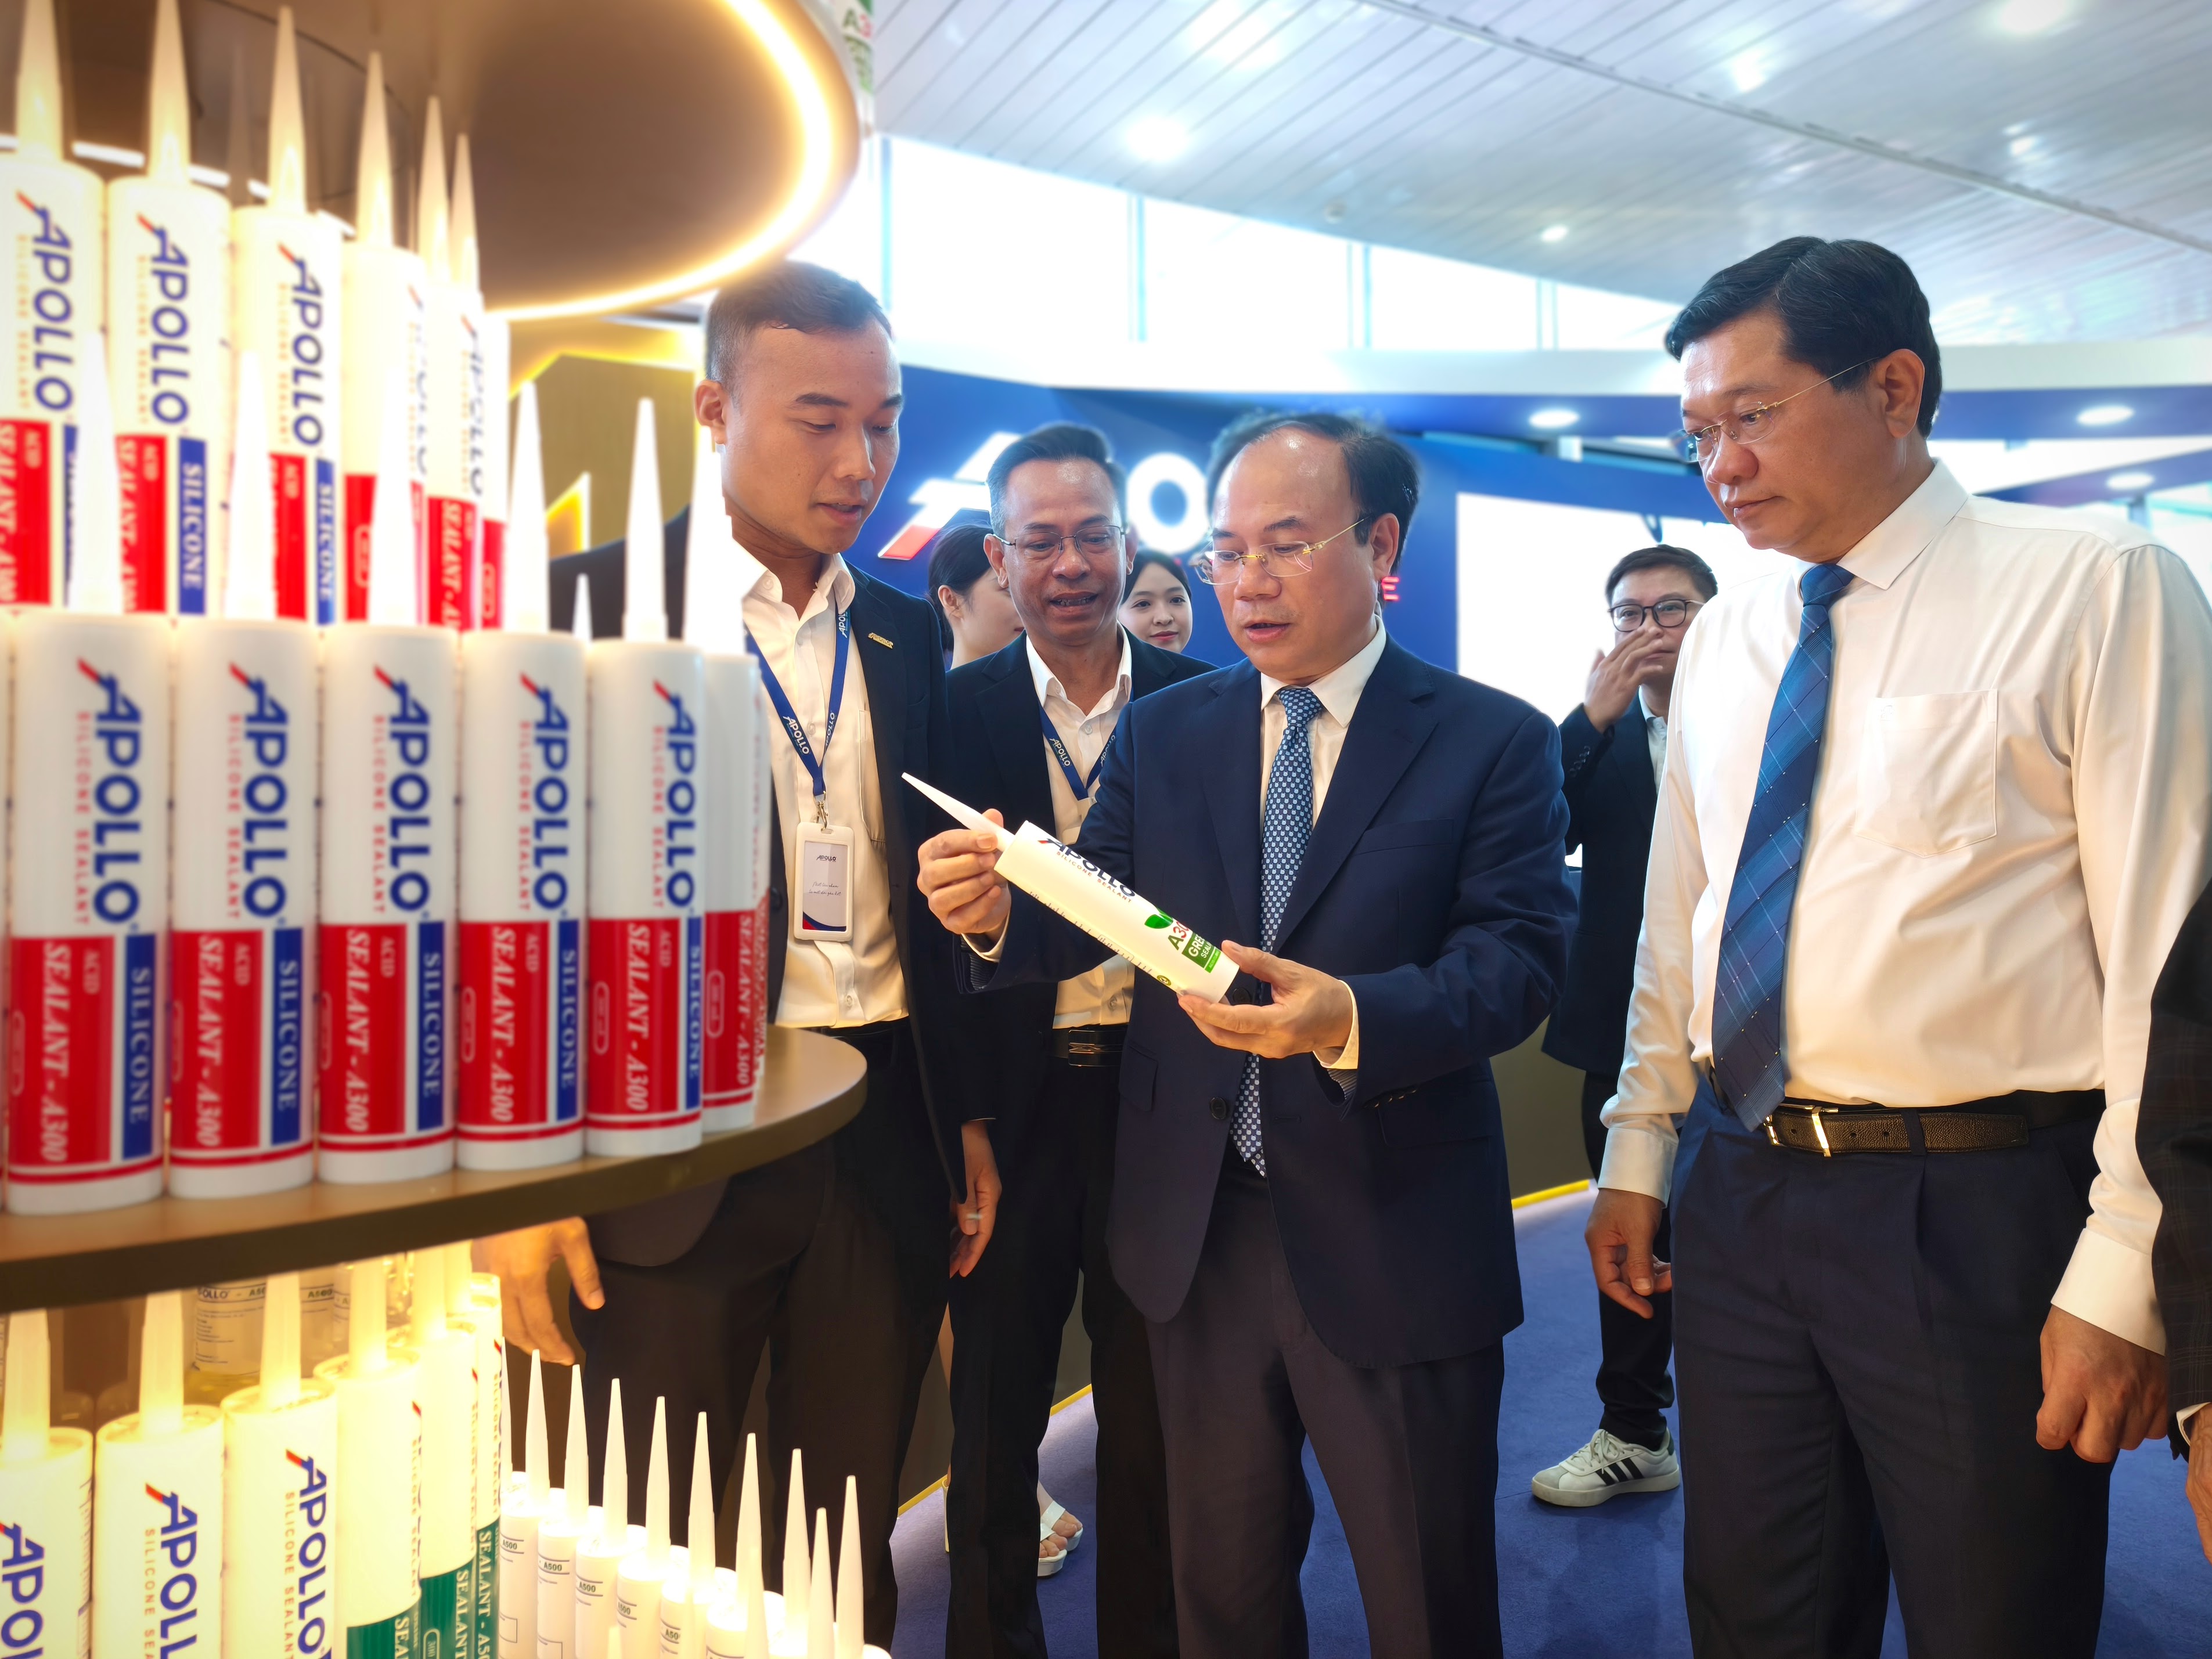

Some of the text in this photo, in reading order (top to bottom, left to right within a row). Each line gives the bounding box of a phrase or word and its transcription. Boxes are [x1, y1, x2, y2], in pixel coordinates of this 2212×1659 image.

[16, 191, 74, 411] APOLLO
[137, 212, 190, 425] APOLLO
[278, 243, 323, 447] APOLLO
[182, 463, 203, 589] SILICONE
[838, 613, 848, 638] APOL
[783, 716, 810, 754] APOLLO
[1049, 738, 1071, 766] APOLLO
[77, 657, 142, 924] APOLLO
[228, 662, 288, 918] APOLLO
[373, 663, 431, 913] APOLLO
[520, 672, 569, 911] APOLLO
[653, 679, 696, 908] APOLLO
[1037, 838, 1135, 897] APOLLO
[1056, 851, 1132, 903] SILICONE SEALANT
[346, 929, 370, 1055] SEALANT
[491, 926, 516, 1047] SEALANT
[627, 922, 651, 1040] SEALANT
[738, 914, 752, 1015] SEALANT
[1188, 933, 1205, 957] GRE
[1201, 942, 1212, 958] SEAL
[43, 940, 71, 1078] SEALANT
[130, 968, 151, 1124] SILICONE
[198, 935, 224, 1066] SEALANT
[278, 960, 298, 1111] SILICONE
[423, 953, 441, 1098] SILICONE
[561, 948, 577, 1089] SILICONE
[41, 1095, 69, 1162] A300
[196, 1083, 222, 1146] A300
[345, 1069, 369, 1133] A300
[490, 1062, 515, 1122] A300
[626, 1054, 649, 1111] A300
[145, 1483, 198, 1659] APOLL
[145, 1528, 156, 1616] SILICONE
[284, 1492, 295, 1575] SILICONE
[286, 1449, 327, 1655] APOLLO
[479, 1530, 492, 1617] SEALANT
[502, 1539, 517, 1550] A500
[543, 1561, 563, 1572] A500
[0, 1523, 45, 1659] APO
[455, 1569, 469, 1659] SEALANT
[579, 1581, 596, 1593] A500
[665, 1628, 680, 1640] A50
[477, 1633, 490, 1659] A5
